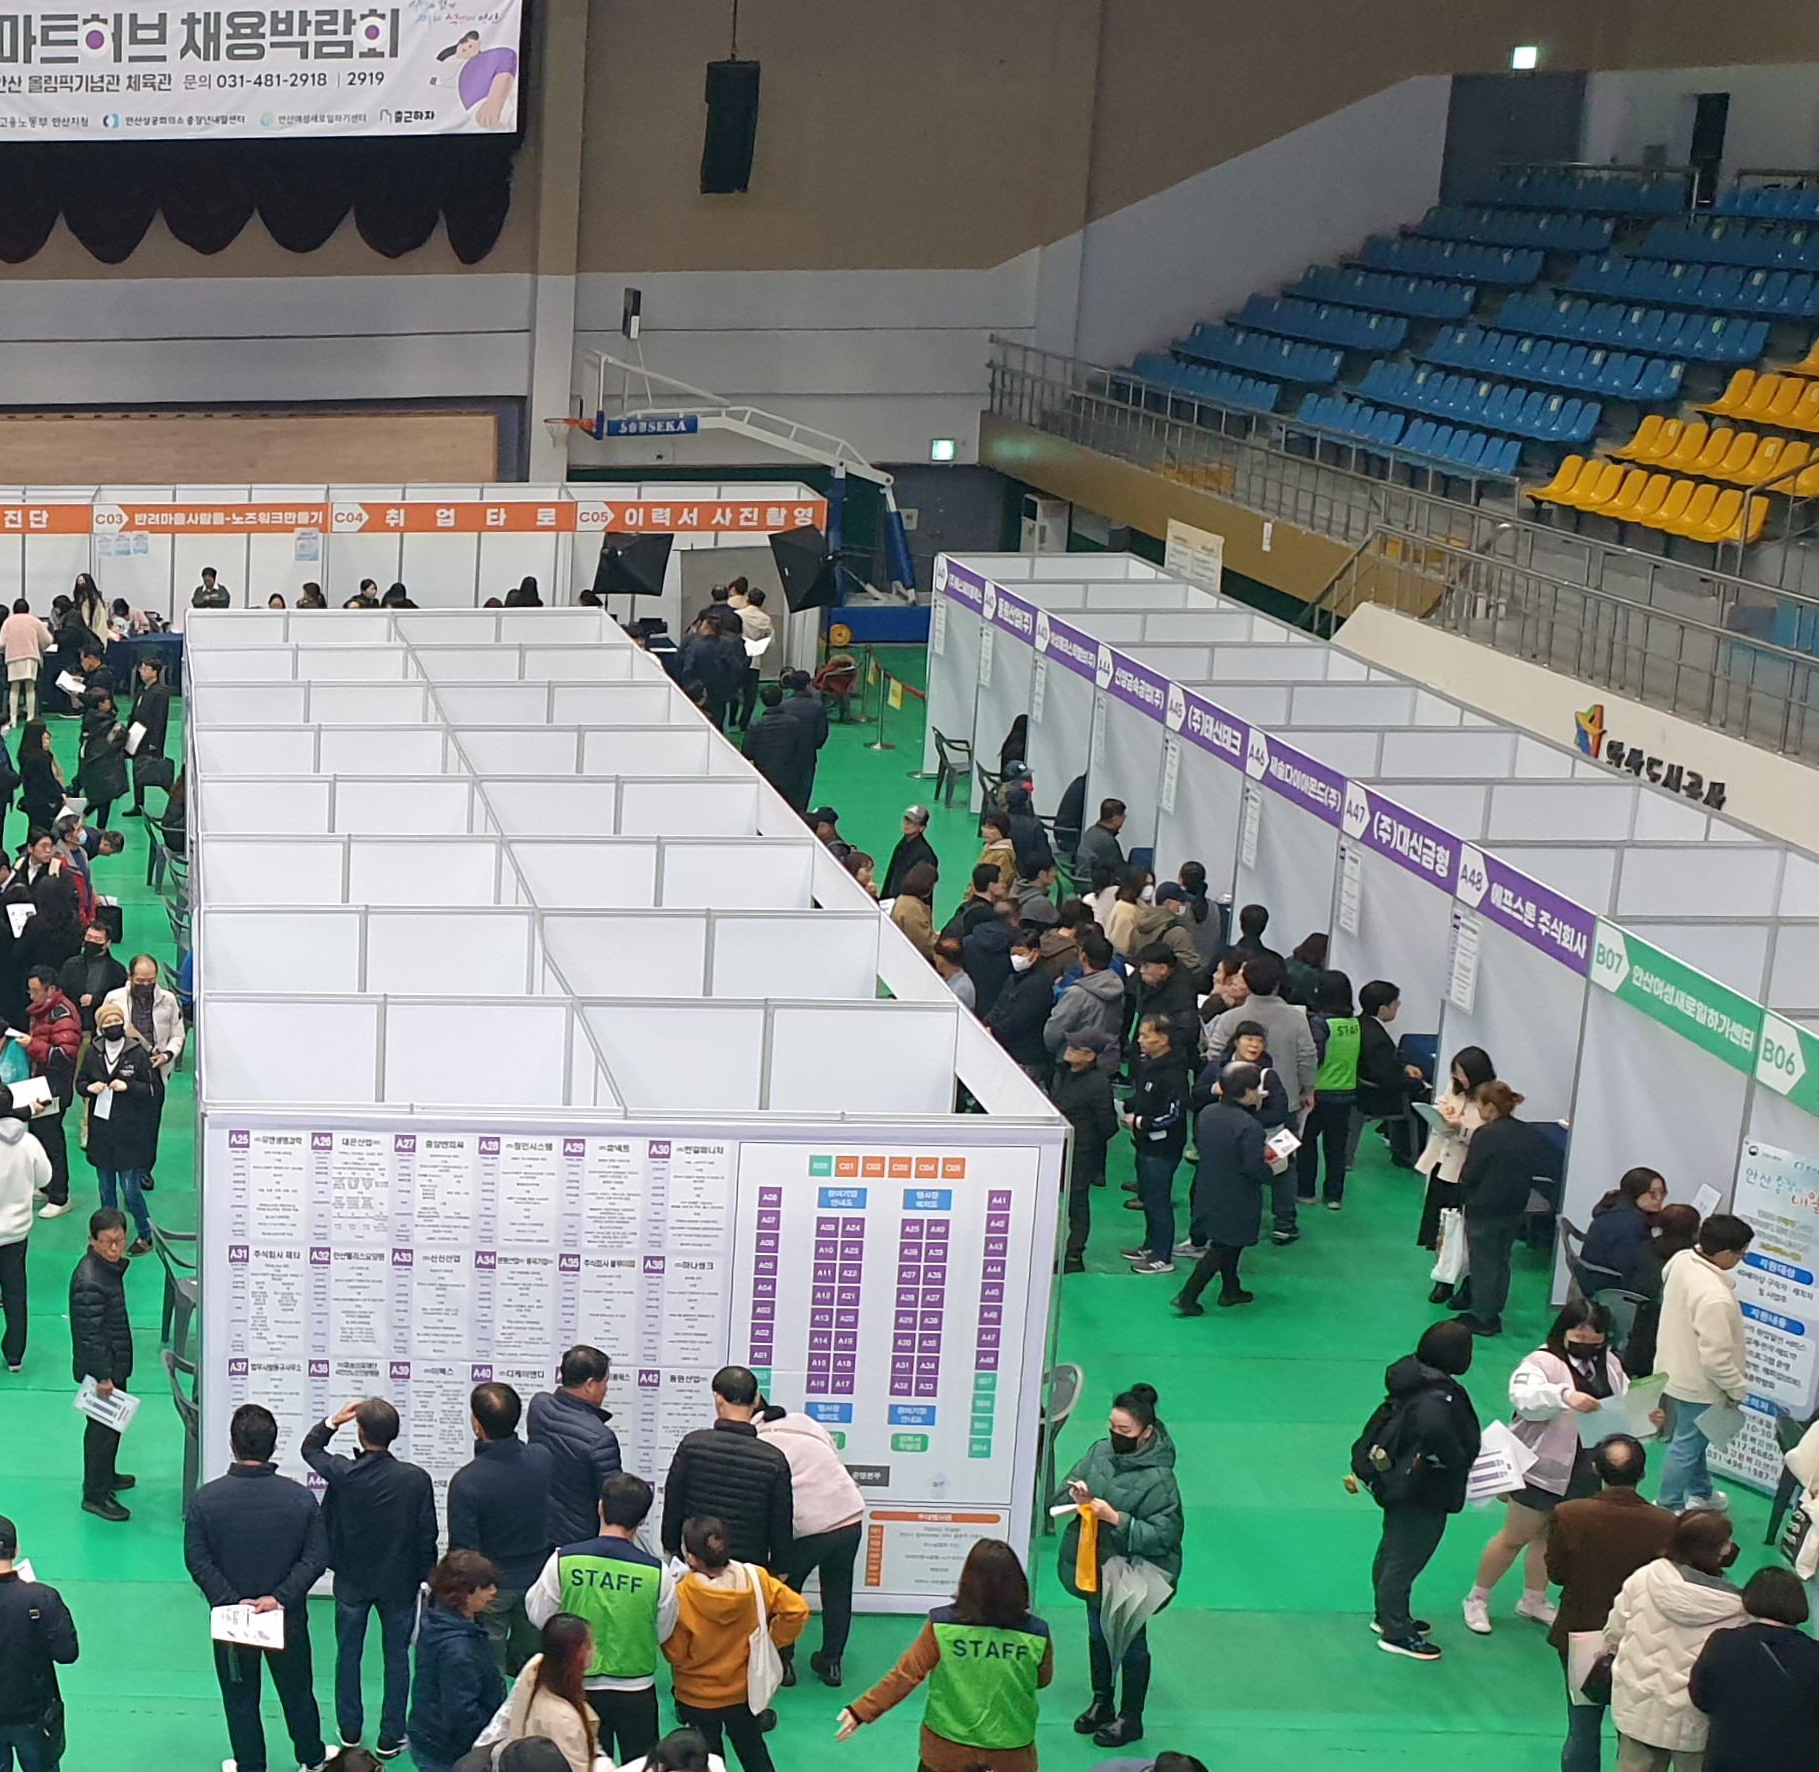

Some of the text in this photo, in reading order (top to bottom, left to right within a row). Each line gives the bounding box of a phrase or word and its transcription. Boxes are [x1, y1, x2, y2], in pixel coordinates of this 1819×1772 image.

[181, 7, 399, 63] 채용박람회
[28, 73, 121, 94] 올림픽기념관
[126, 72, 173, 93] 체육관
[183, 73, 212, 90] 문의
[216, 72, 328, 89] 031-481-2918
[347, 71, 385, 87] 2919
[0, 116, 89, 128] 고용노동부 안산지청
[394, 110, 435, 123] 출근하자
[4, 509, 50, 529] 진단
[95, 514, 123, 524] C03
[334, 513, 363, 523] C04
[579, 512, 609, 523] C05
[624, 507, 814, 527] 이력서 사진촬영
[1098, 657, 1111, 674] A44
[1168, 701, 1183, 719] A45
[1249, 743, 1265, 766] A46
[1346, 799, 1366, 824] A47
[1373, 810, 1450, 879] (주)대신금형
[1460, 863, 1483, 892] A48
[1491, 881, 1587, 959] 에프스톤 주식회사
[1596, 943, 1624, 975] B07
[1632, 964, 1755, 1052] 안산여성새로일하기센터
[1762, 1037, 1796, 1077] B06
[231, 1134, 249, 1146] A25
[396, 1138, 415, 1149] A27
[230, 1248, 248, 1260] A31
[311, 1250, 330, 1261] A32
[476, 1255, 496, 1266] A34
[229, 1360, 248, 1372] A37
[473, 1368, 492, 1379] A40
[639, 1373, 659, 1384] A42
[570, 1567, 644, 1595] STAFF
[952, 1638, 1030, 1661] STAFF
